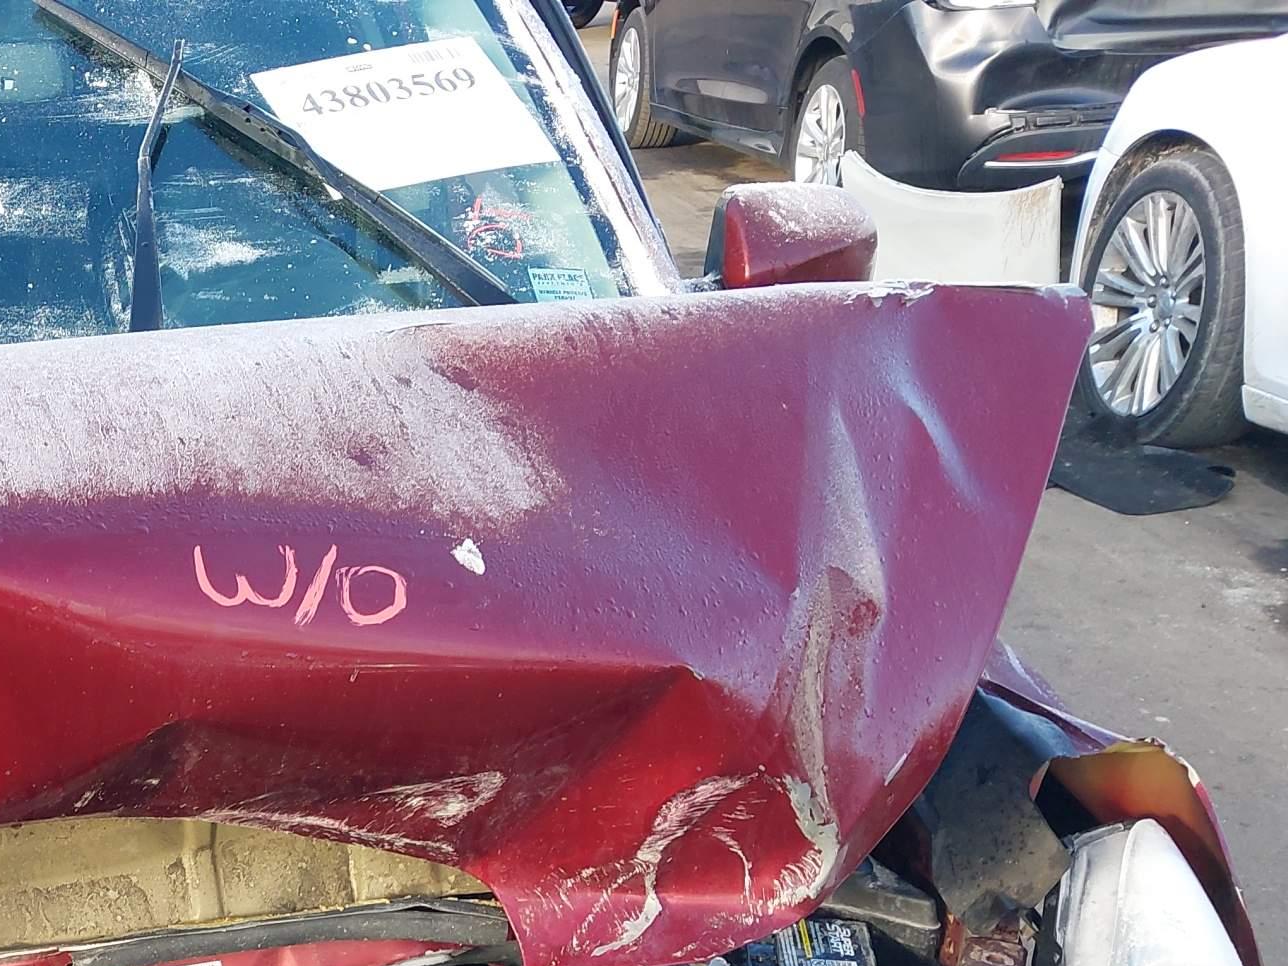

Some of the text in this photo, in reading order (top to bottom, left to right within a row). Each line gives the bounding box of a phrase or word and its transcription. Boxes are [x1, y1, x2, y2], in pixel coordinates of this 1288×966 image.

[302, 67, 476, 115] 43803569
[825, 922, 844, 957] START
[839, 927, 855, 956] SUPER
